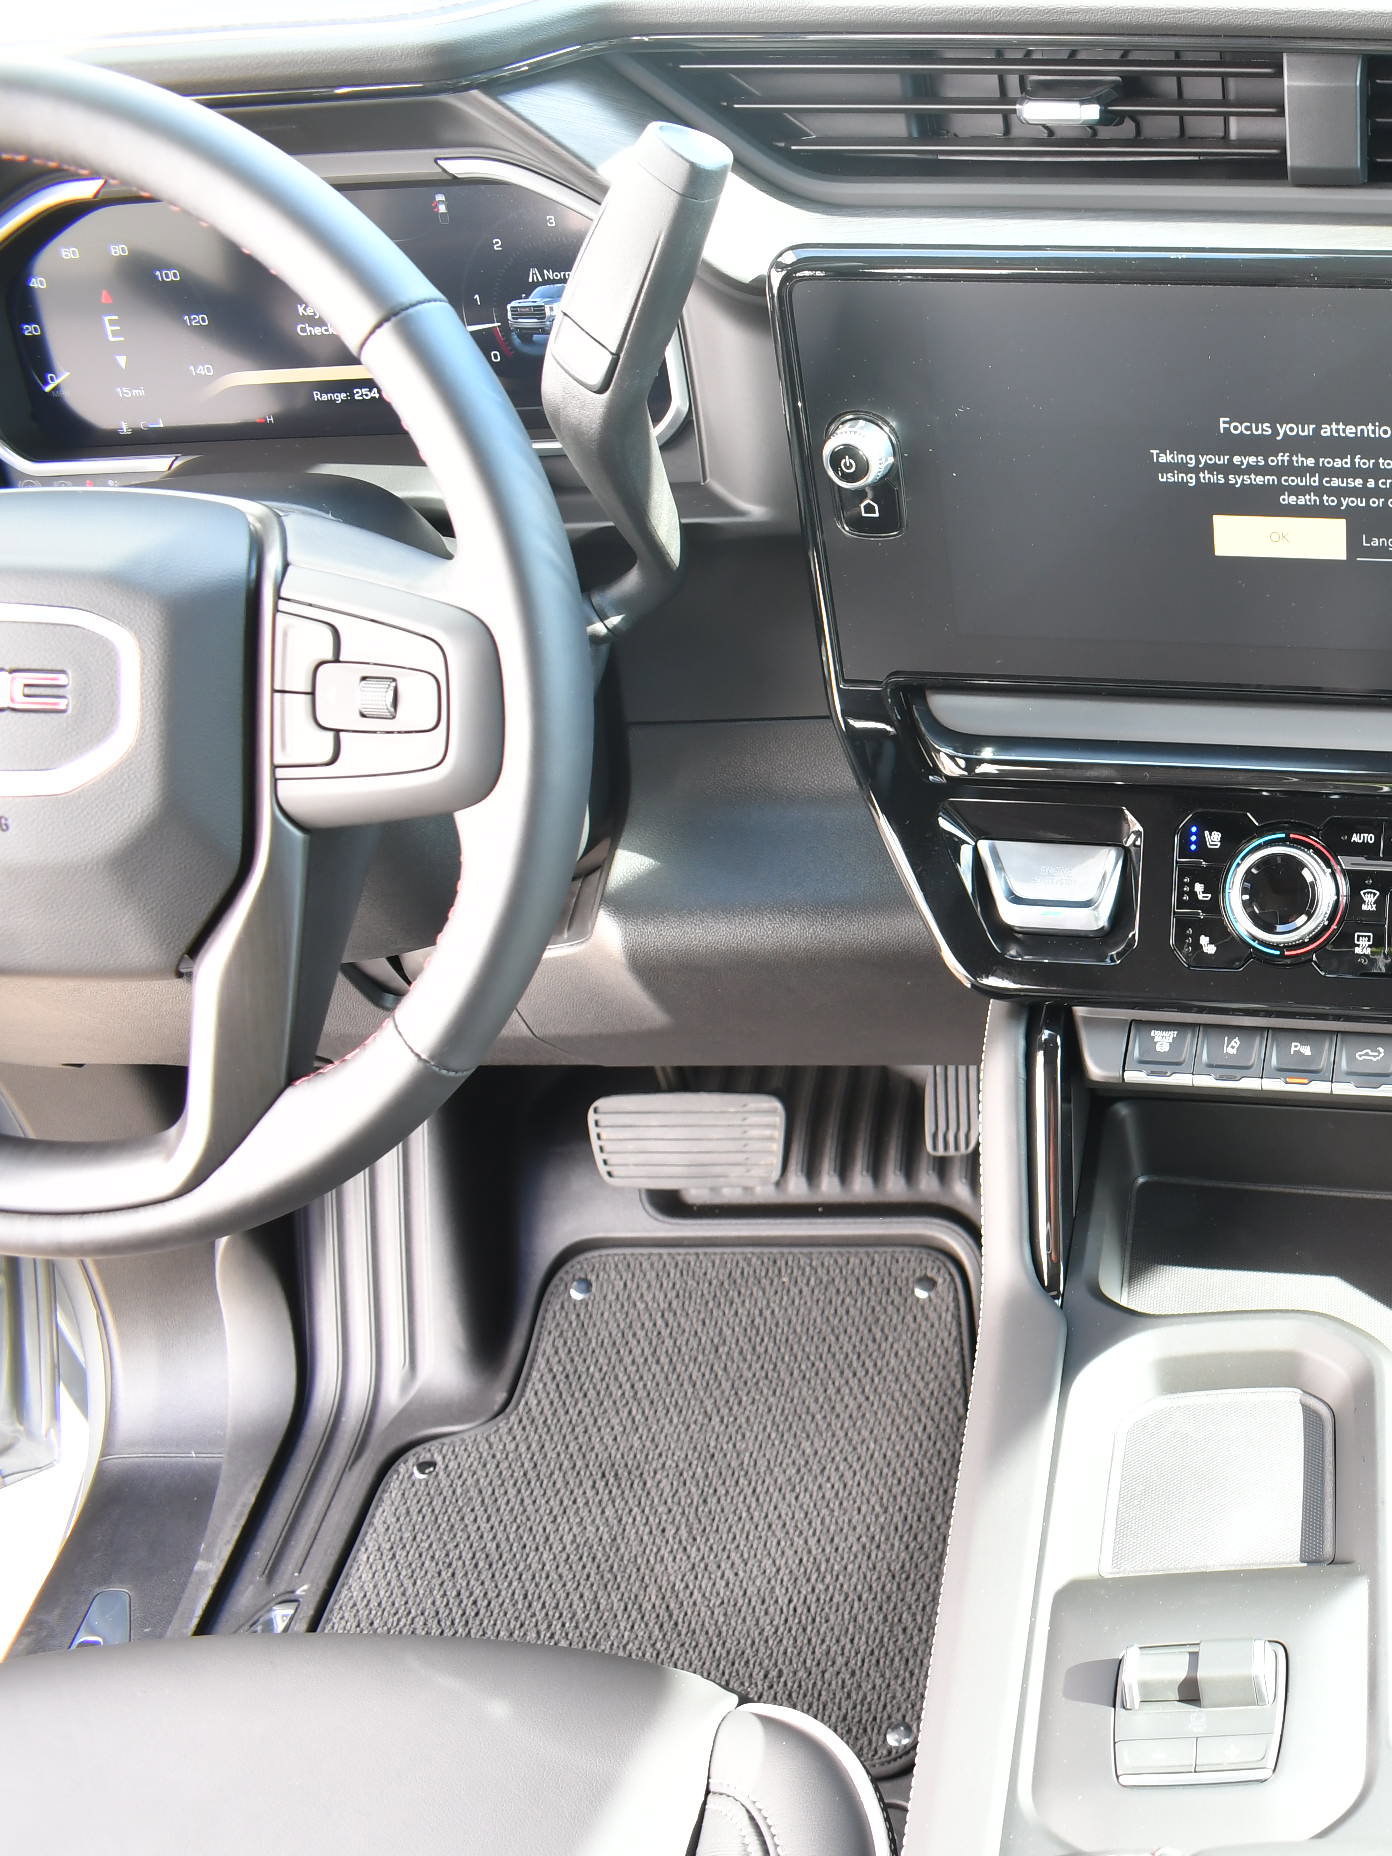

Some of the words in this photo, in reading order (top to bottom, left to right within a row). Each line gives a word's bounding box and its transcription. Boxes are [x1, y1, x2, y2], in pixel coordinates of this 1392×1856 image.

[546, 216, 556, 226] 3
[493, 239, 502, 250] 2
[61, 248, 80, 259] 60
[111, 245, 128, 256] 80
[155, 269, 180, 281] 100
[30, 278, 46, 288] 40
[474, 294, 481, 305] 1
[184, 314, 208, 326] 120
[23, 325, 41, 335] 20
[103, 316, 125, 341] E
[296, 323, 337, 336] Check
[491, 351, 501, 362] 0
[189, 364, 213, 376] 140
[48, 374, 57, 384] 0
[313, 391, 350, 404] Range:
[354, 387, 379, 400] 254
[266, 415, 274, 424] H
[1219, 418, 1271, 435] Focus
[1276, 423, 1316, 440] your
[1150, 450, 1195, 467] Taking
[1199, 454, 1229, 468] your
[1233, 456, 1265, 469] eyes
[1268, 453, 1290, 466] off
[1291, 453, 1315, 467] the
[1319, 455, 1350, 468] road
[1354, 455, 1375, 468] for
[1158, 470, 1196, 486] using
[1199, 471, 1225, 484] this
[1228, 474, 1278, 488] system
[1281, 473, 1318, 487] could
[1323, 478, 1363, 488] cause
[1366, 478, 1375, 488] a
[1279, 491, 1320, 505] death
[1323, 494, 1337, 506] to
[1340, 496, 1365, 509] you
[1369, 498, 1384, 507] or
[1269, 531, 1290, 543] OK
[1351, 833, 1375, 844] AUTO
[1361, 903, 1377, 911] MAX
